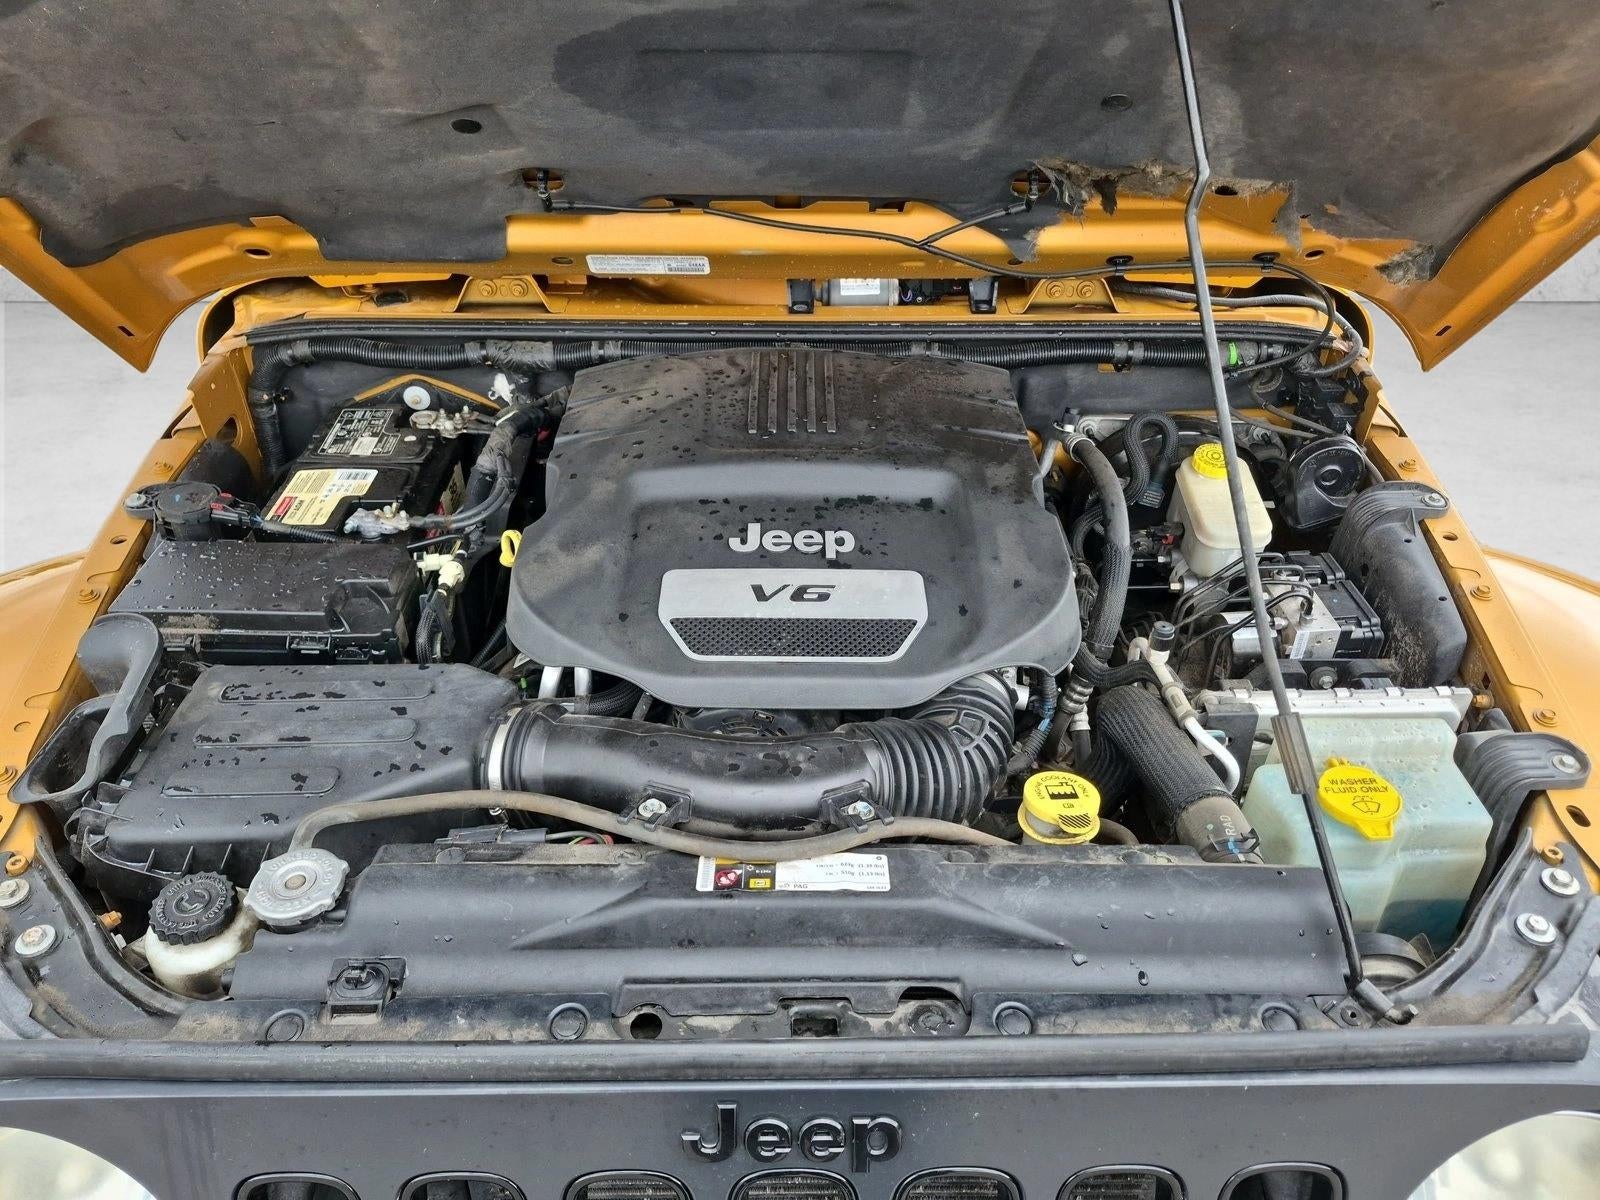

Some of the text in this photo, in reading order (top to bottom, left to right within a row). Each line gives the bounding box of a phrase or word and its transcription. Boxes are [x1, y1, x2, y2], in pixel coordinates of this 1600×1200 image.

[728, 522, 855, 559] Jeep
[750, 584, 836, 602] V6
[1040, 775, 1078, 783] COOLANT
[1078, 783, 1089, 798] ONLY
[1324, 785, 1389, 794] FLUID ONLY
[1328, 777, 1378, 786] WASHER
[1219, 814, 1238, 836] RAD
[681, 1101, 903, 1173] Jeep
